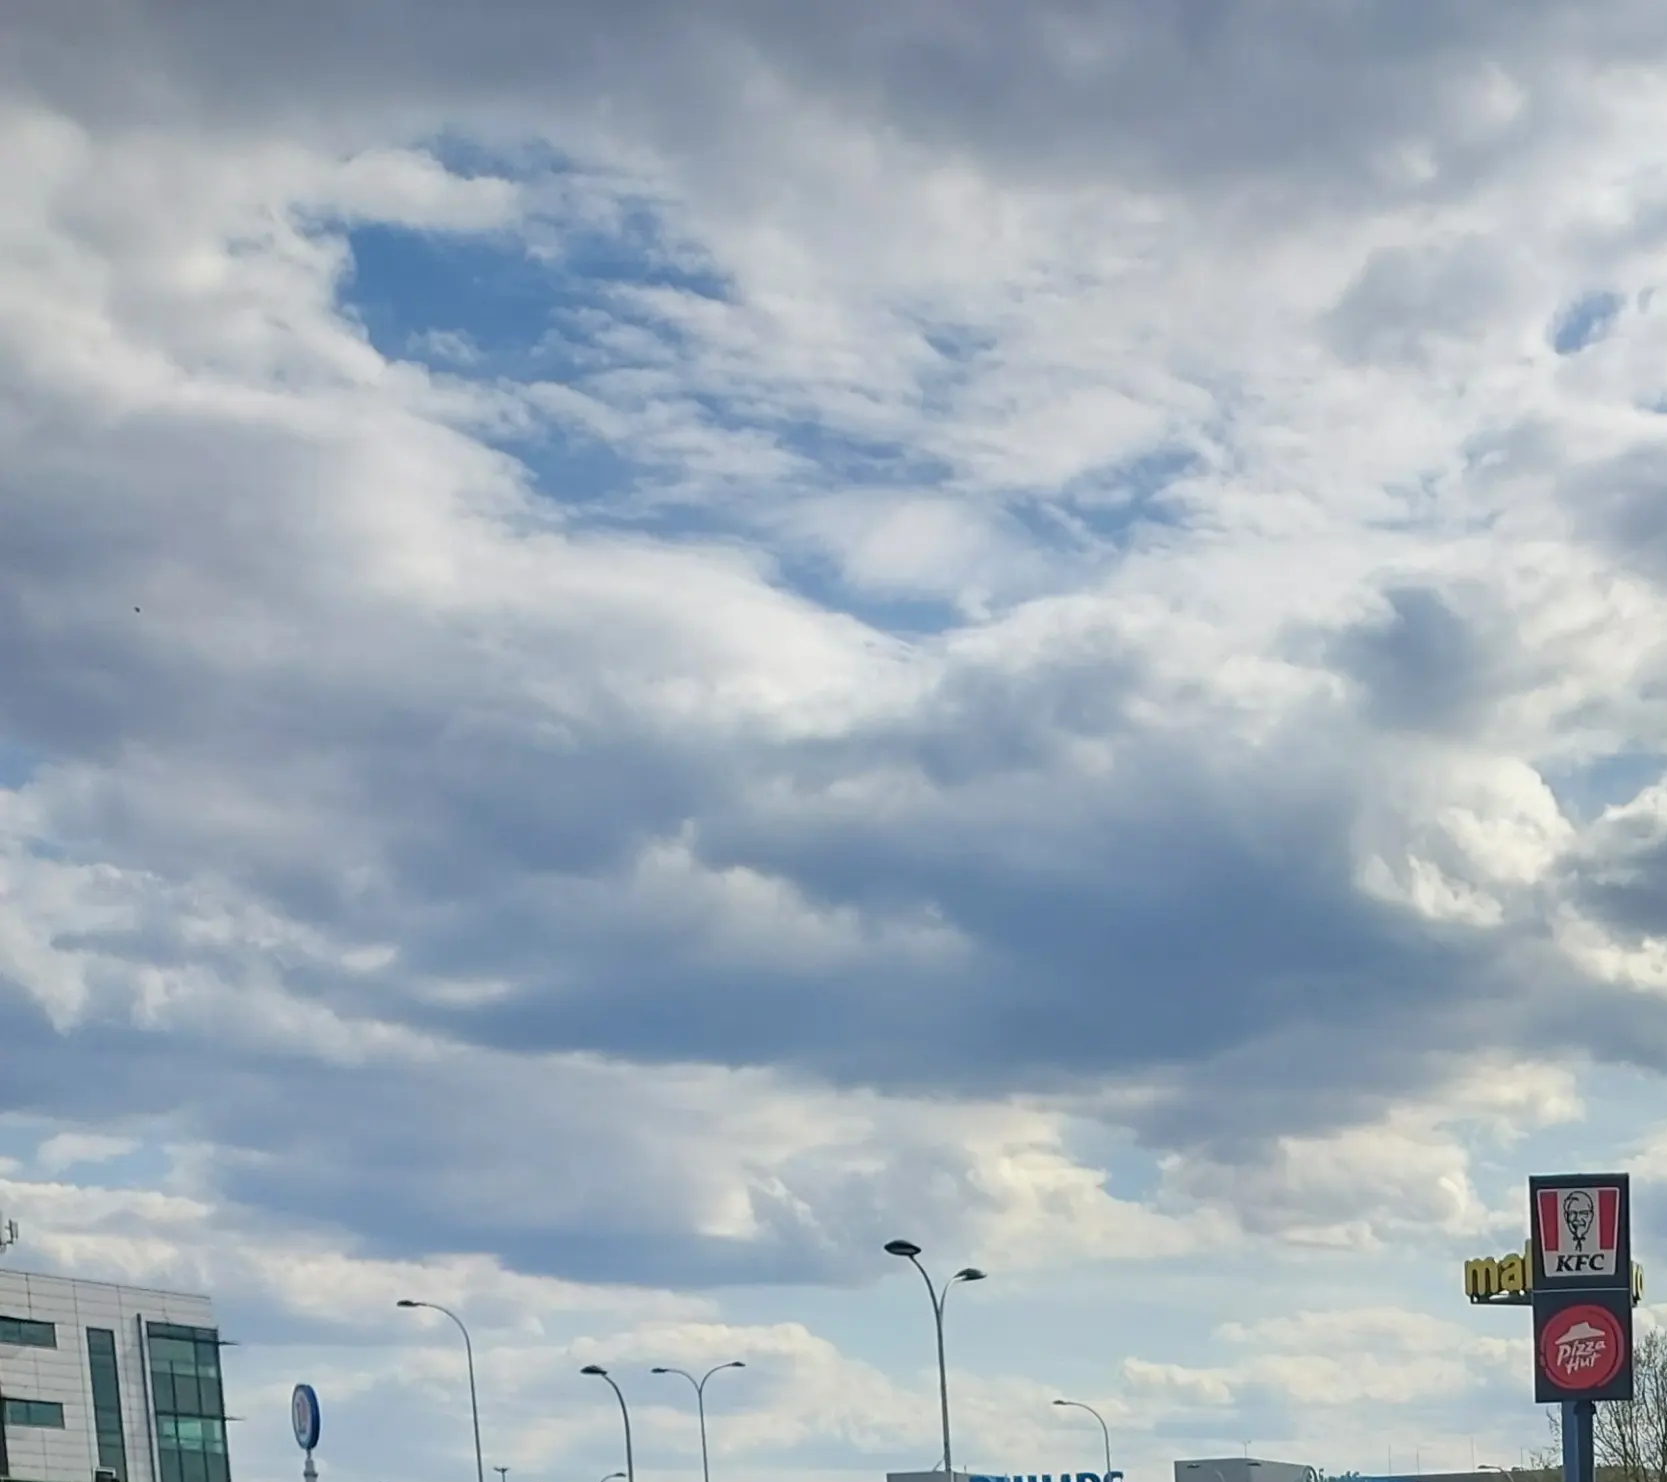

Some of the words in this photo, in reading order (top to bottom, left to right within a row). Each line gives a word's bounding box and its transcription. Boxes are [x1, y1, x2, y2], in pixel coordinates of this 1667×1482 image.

[1556, 1253, 1605, 1272] KFC
[1556, 1340, 1606, 1366] Pizza
[1565, 1352, 1601, 1375] Hut
